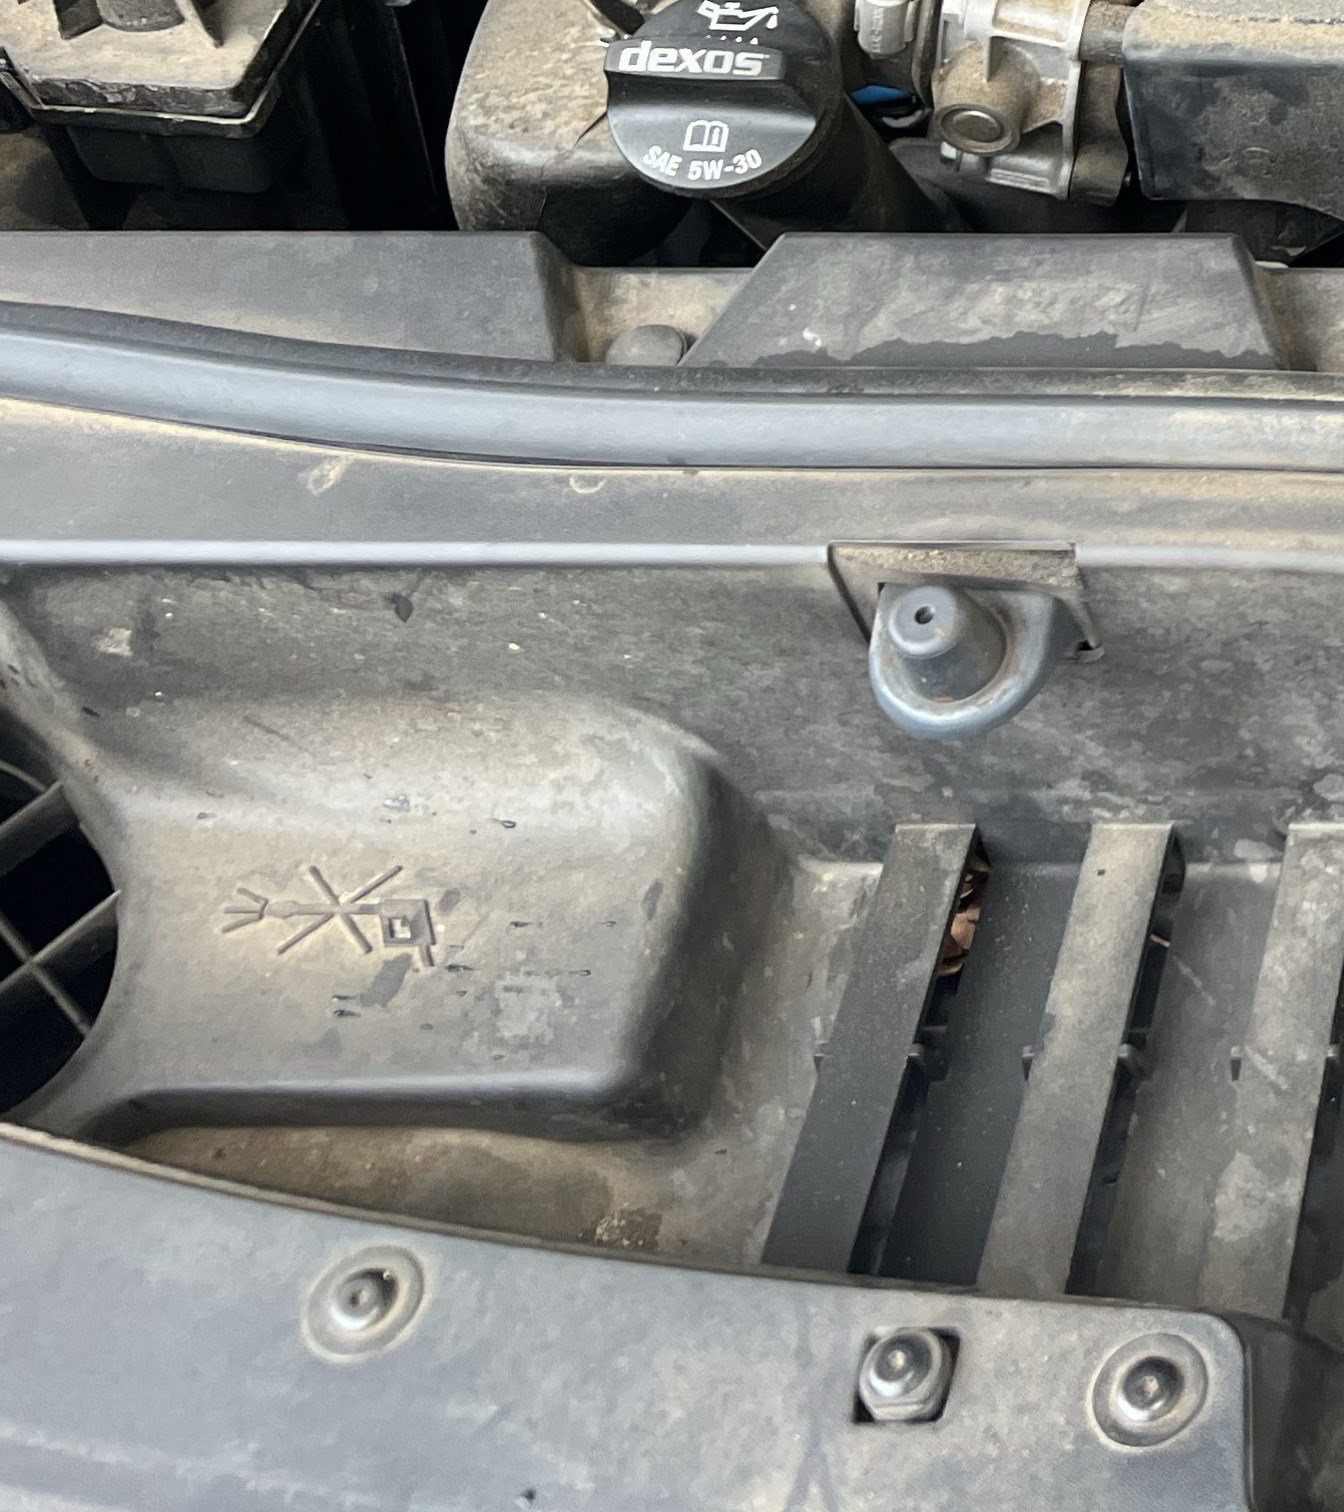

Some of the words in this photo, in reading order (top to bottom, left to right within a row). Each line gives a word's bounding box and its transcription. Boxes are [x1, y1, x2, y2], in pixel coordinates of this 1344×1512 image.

[618, 40, 764, 77] dexos
[642, 144, 683, 178] SAE
[687, 148, 763, 181] 5W-30
